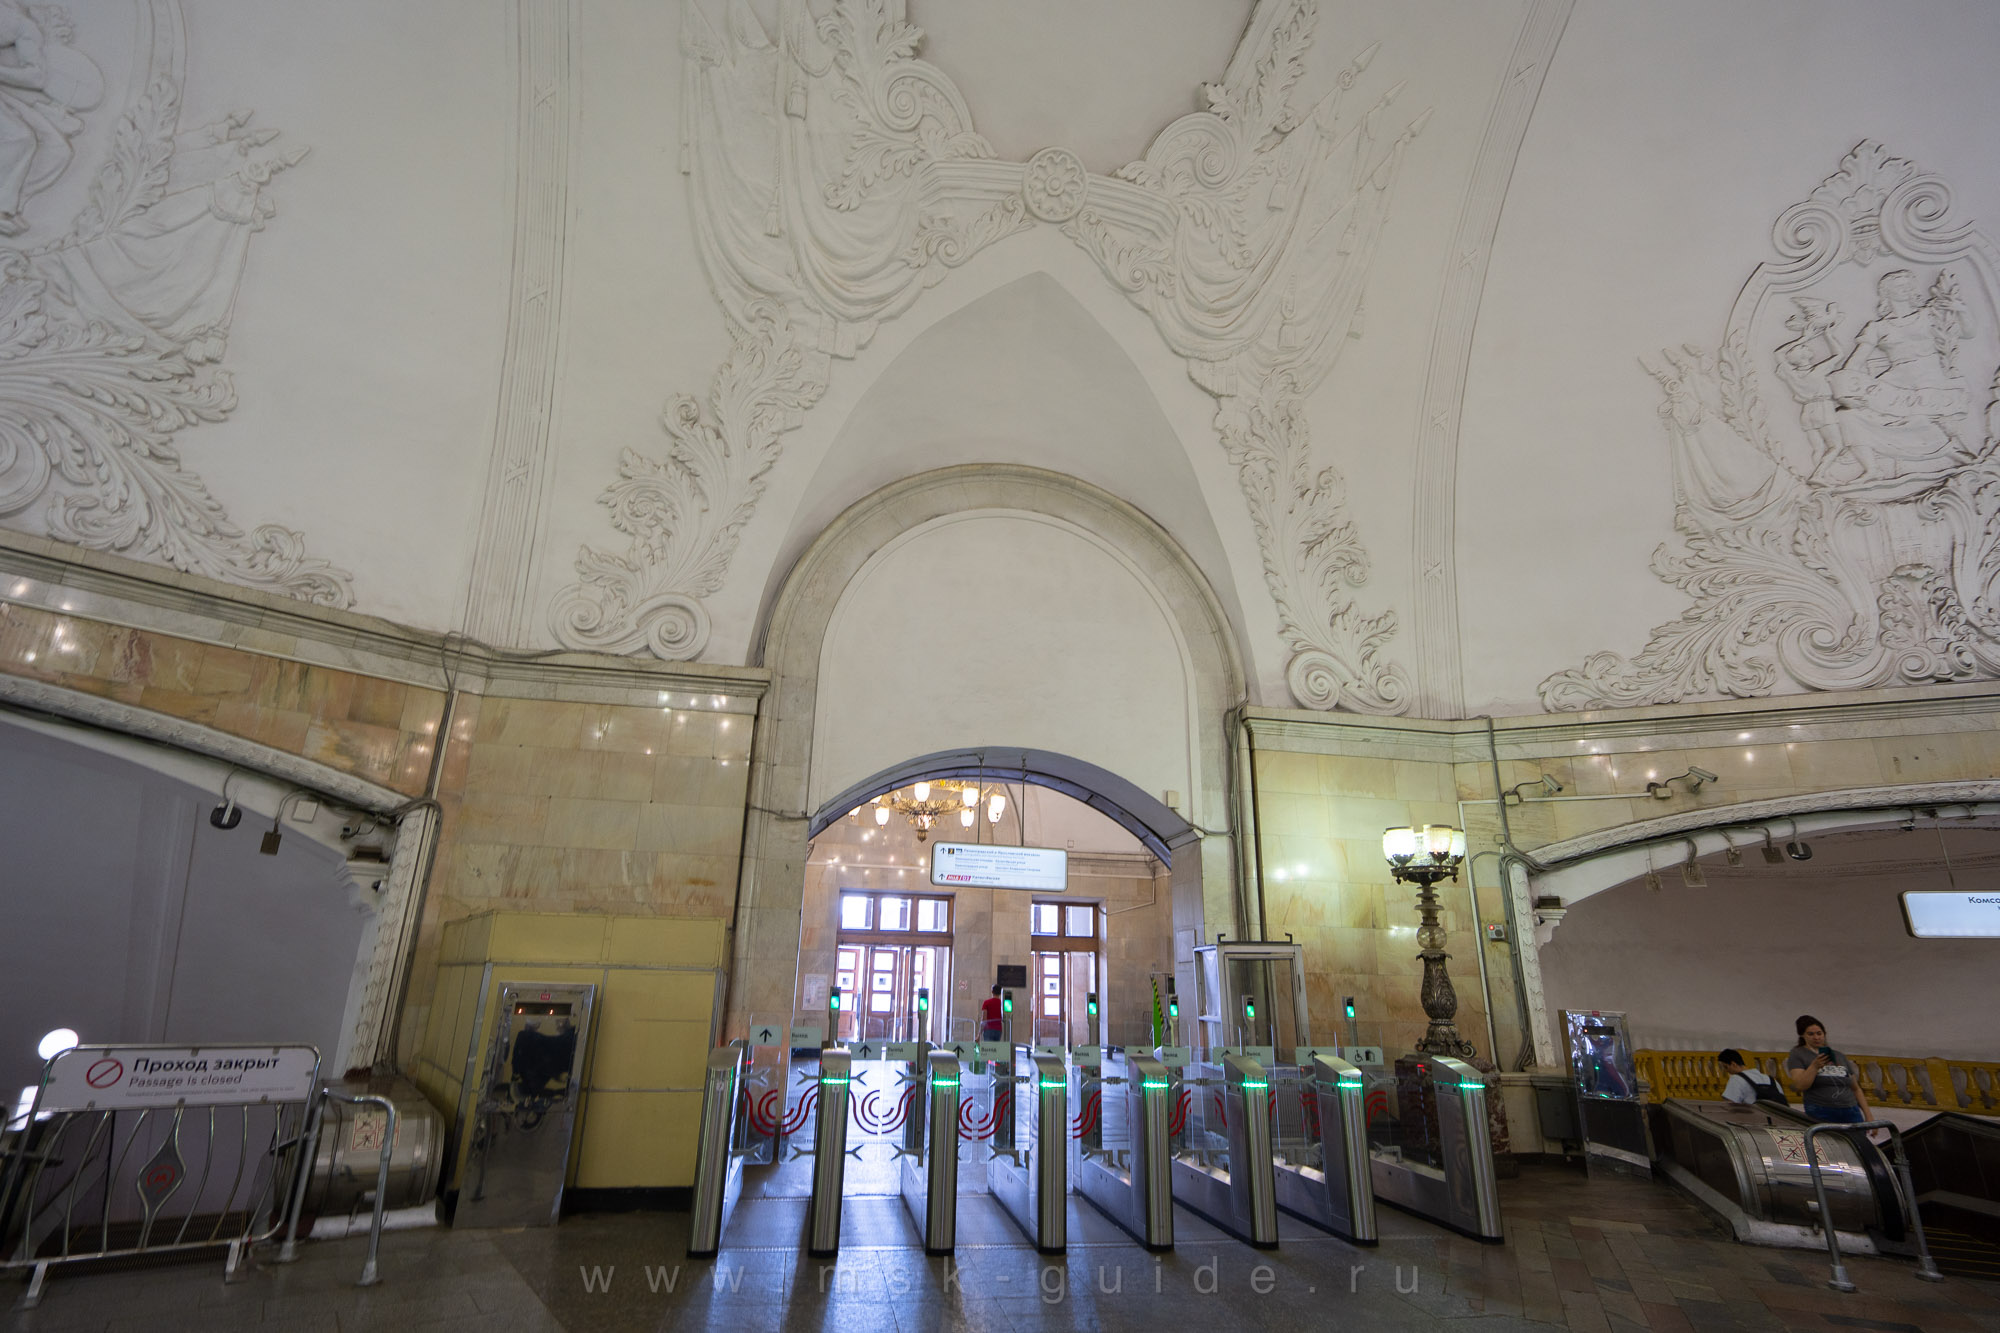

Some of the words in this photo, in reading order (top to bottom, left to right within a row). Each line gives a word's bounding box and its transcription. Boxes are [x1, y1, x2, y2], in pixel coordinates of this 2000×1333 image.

[133, 1057, 208, 1075] Проход
[213, 1057, 280, 1071] закрыт
[128, 1075, 183, 1088] Passage
[187, 1074, 197, 1085] is
[200, 1073, 243, 1085] closed
